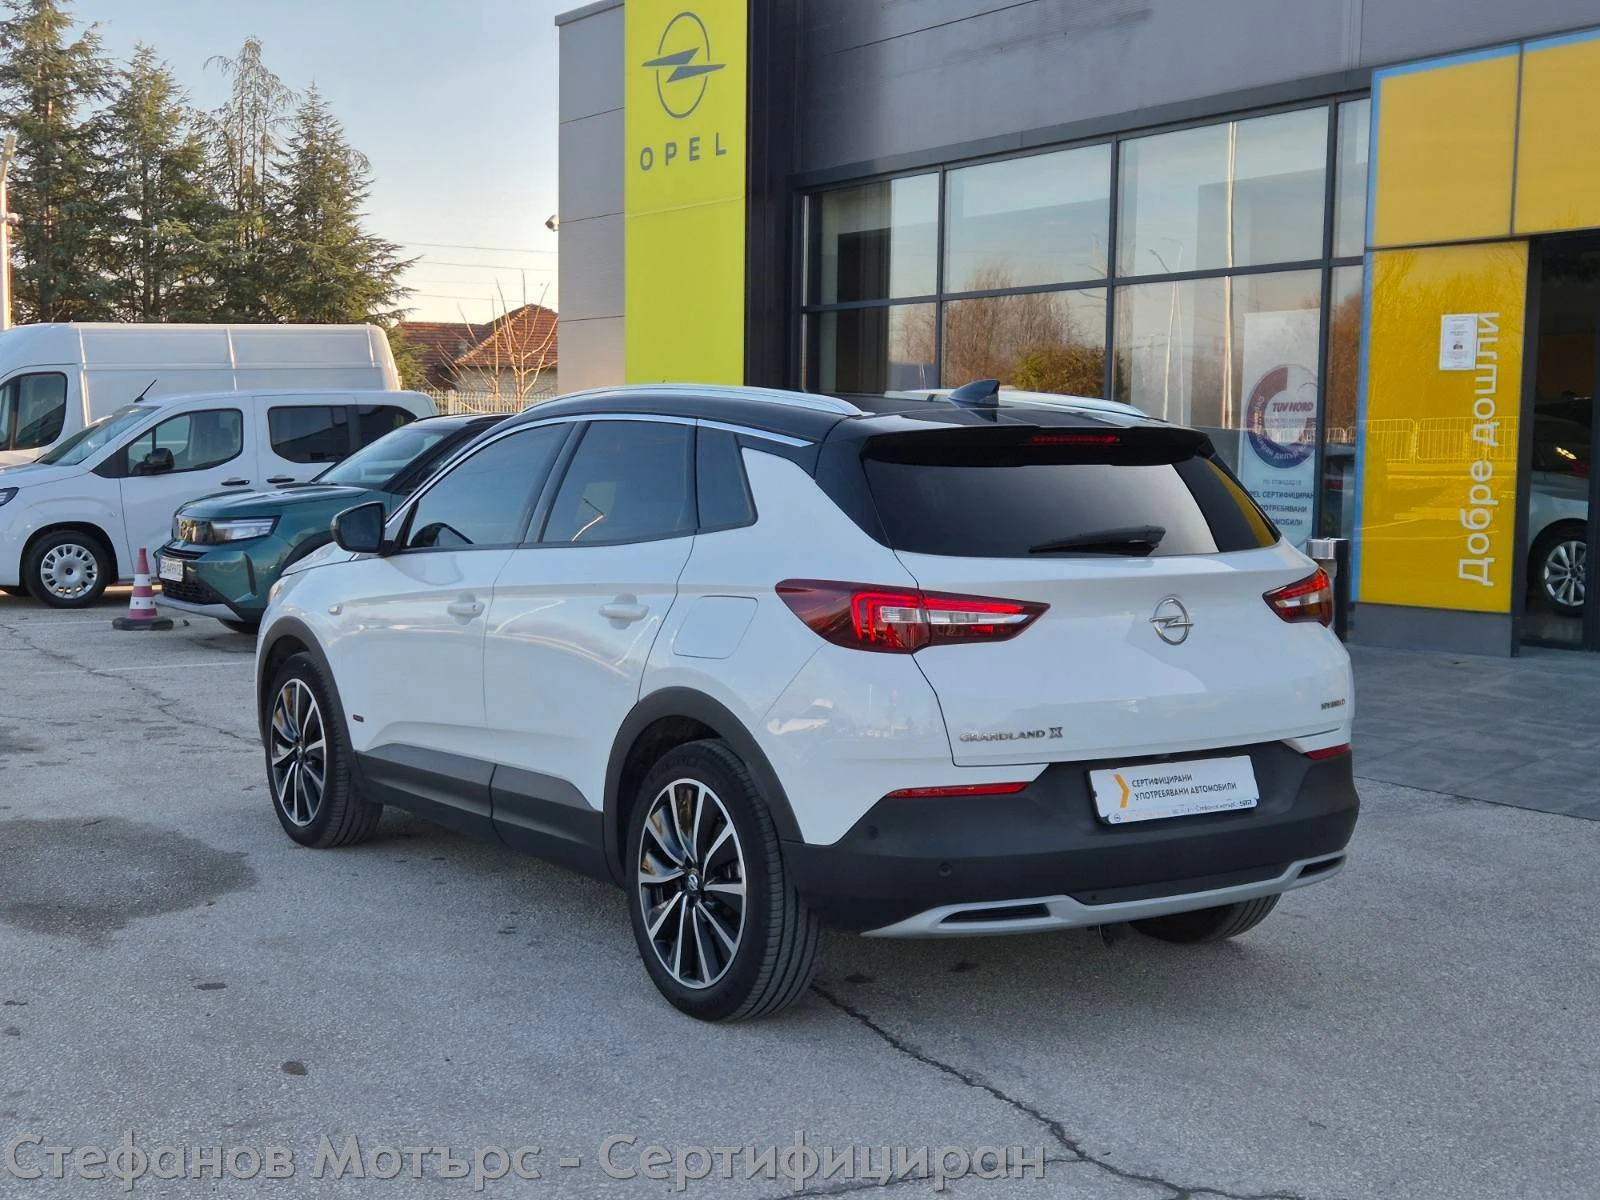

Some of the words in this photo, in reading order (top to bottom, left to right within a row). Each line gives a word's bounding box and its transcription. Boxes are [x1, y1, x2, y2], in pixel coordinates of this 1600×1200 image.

[639, 132, 727, 171] OPEL
[1472, 312, 1500, 447] дошли
[1289, 401, 1314, 412] NORD
[1458, 460, 1499, 586] Добре
[1048, 726, 1064, 739] X
[1131, 774, 1193, 788] СЕРТИФИЦИРАНИ
[1134, 787, 1190, 801] УПОТРЕБЯВАНИ
[1190, 782, 1238, 795] АВТОМОБИЛИ
